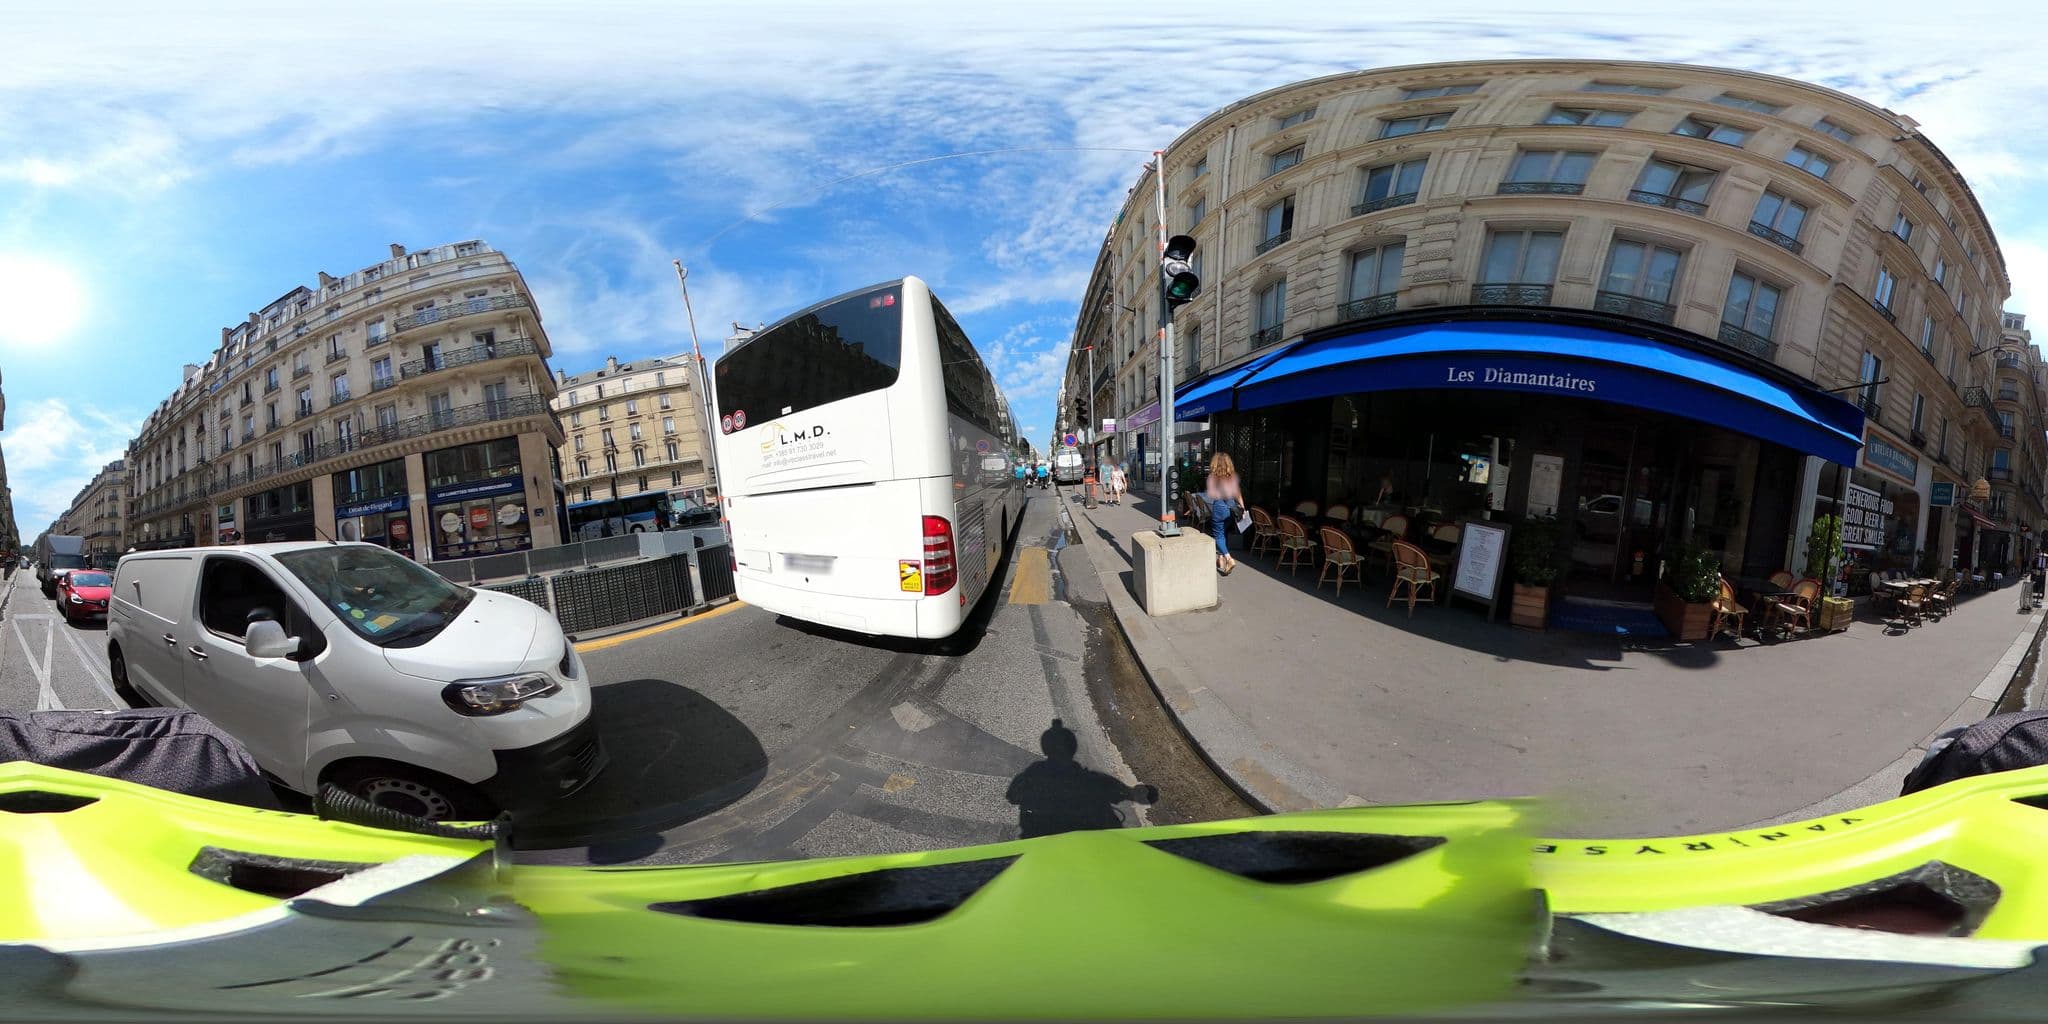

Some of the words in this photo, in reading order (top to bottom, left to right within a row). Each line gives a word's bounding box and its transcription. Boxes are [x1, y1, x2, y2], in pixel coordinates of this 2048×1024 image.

[1447, 367, 1475, 382] Les
[1484, 367, 1596, 392] Diamantaires
[780, 425, 831, 445] L.M.D.
[1847, 488, 1880, 512] GENEROUS
[1880, 498, 1894, 515] FOOD
[1845, 507, 1863, 525] GOOD
[1864, 511, 1879, 529] BEER
[1843, 525, 1864, 543] GREAT
